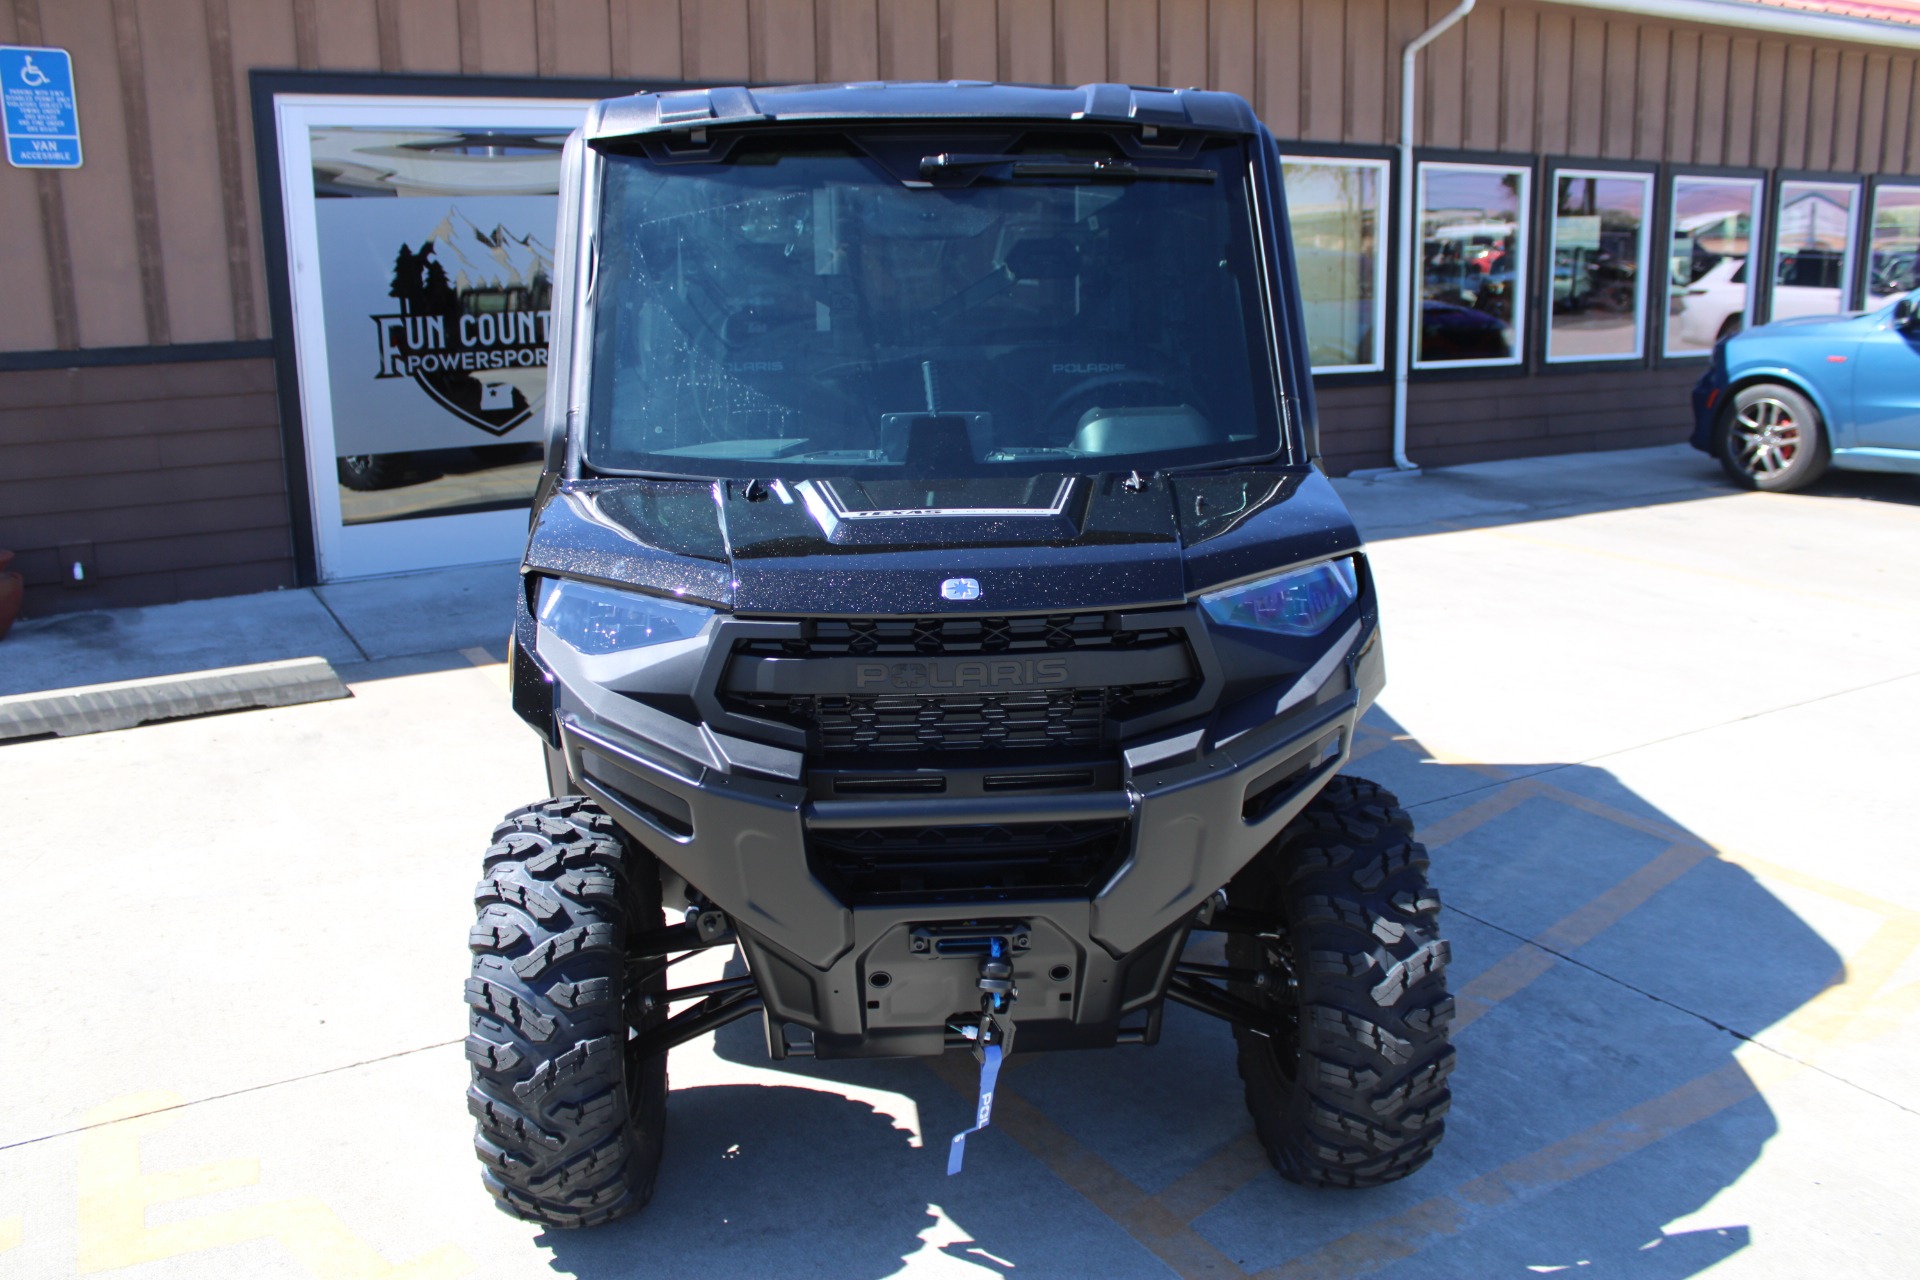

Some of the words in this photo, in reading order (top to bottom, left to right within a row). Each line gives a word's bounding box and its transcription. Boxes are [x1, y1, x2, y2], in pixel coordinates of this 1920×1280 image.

[20, 151, 71, 161] ACCESSIBLE
[32, 140, 58, 152] VAN
[369, 313, 446, 379] FUN
[855, 657, 1070, 689] POLARIS
